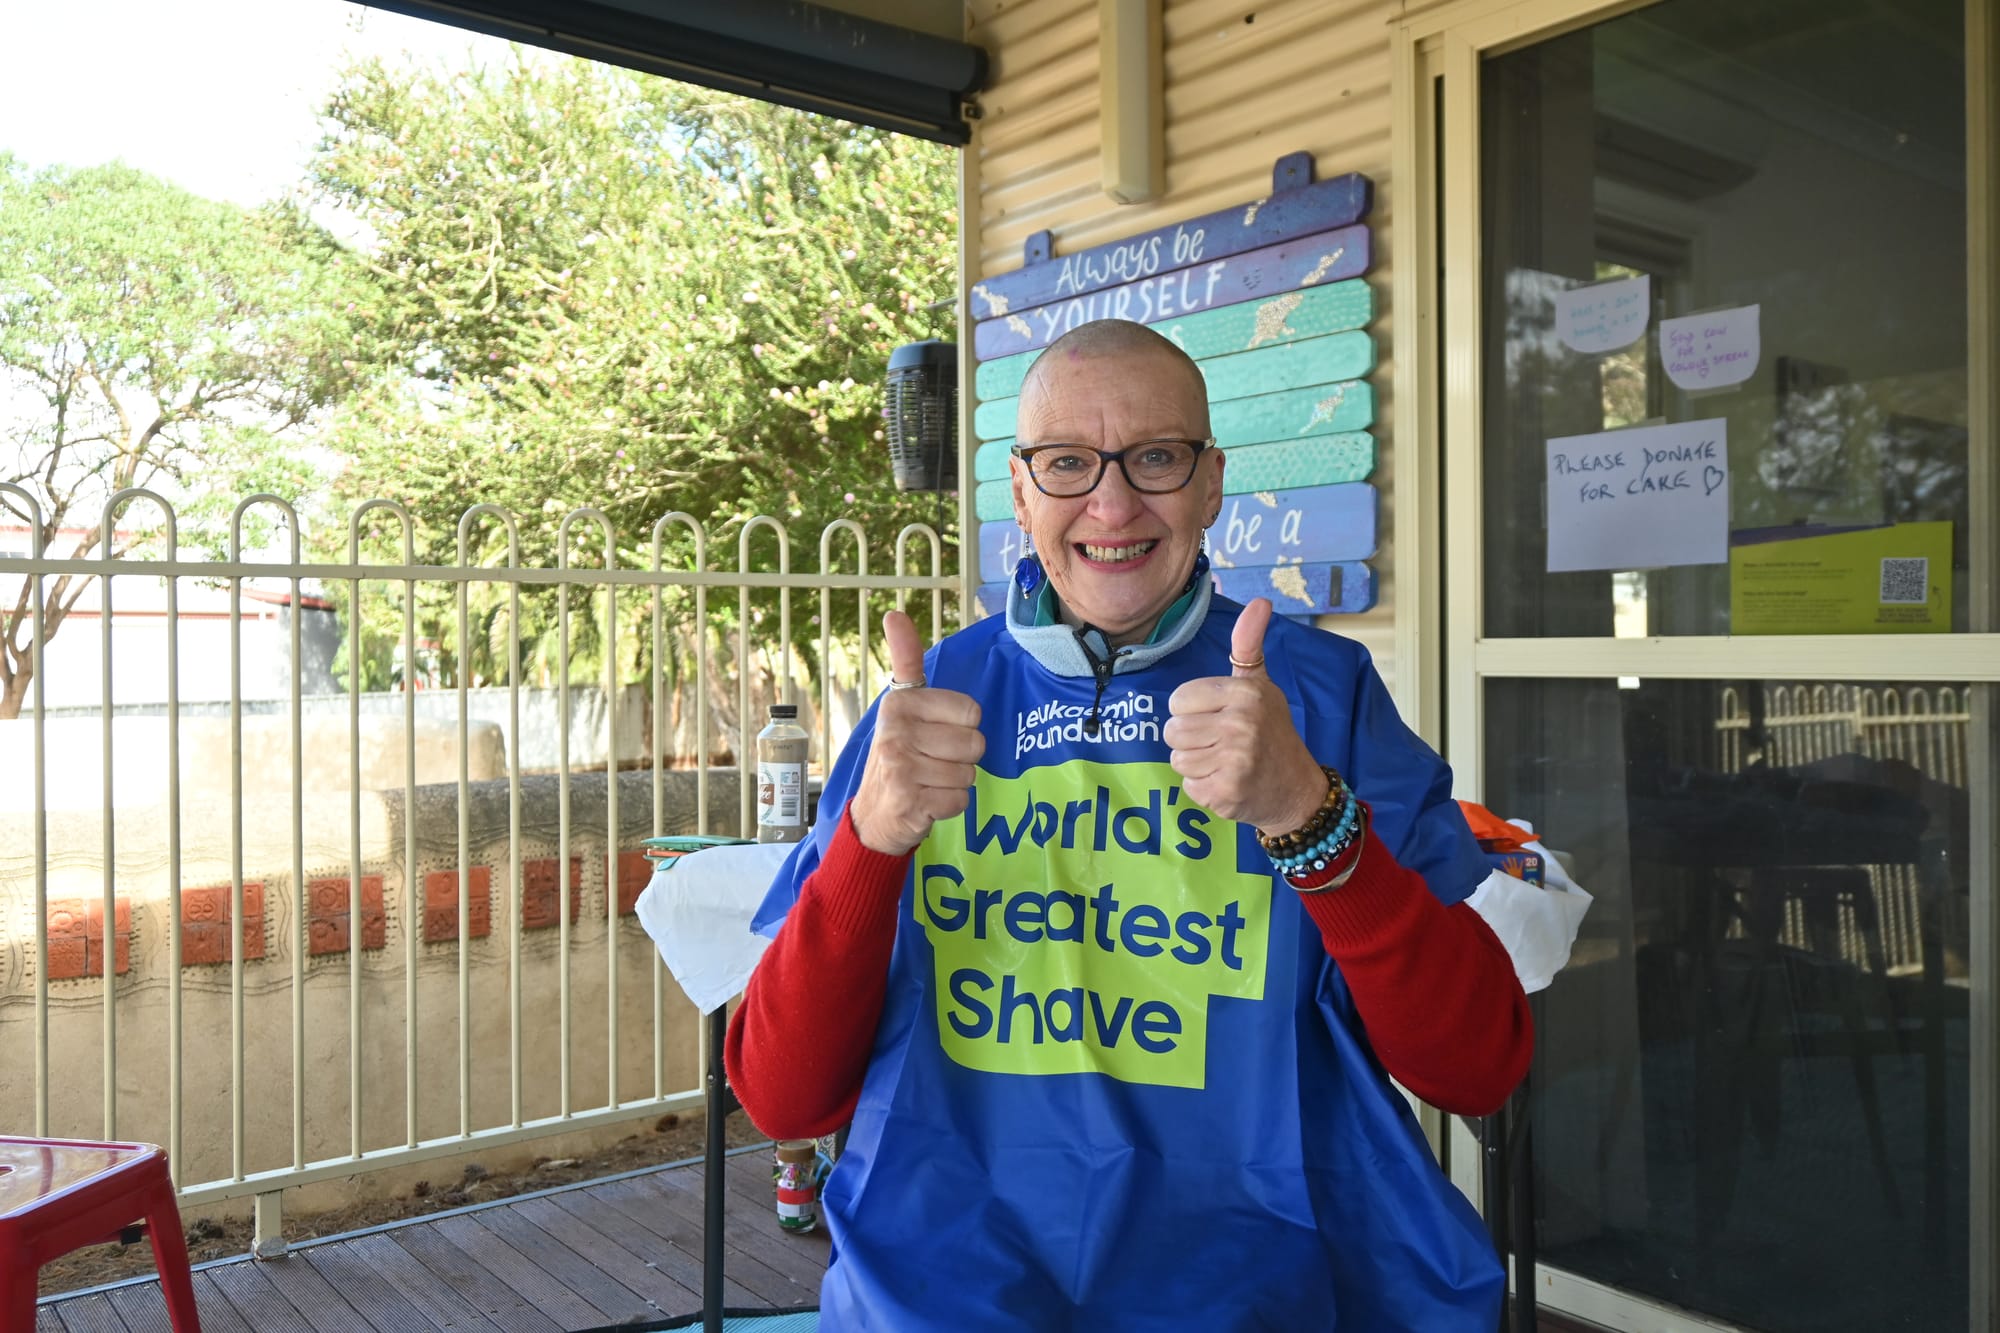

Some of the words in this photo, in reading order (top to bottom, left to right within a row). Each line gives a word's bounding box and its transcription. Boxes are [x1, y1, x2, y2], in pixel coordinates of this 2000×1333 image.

[1056, 236, 1162, 294] Always
[1174, 224, 1205, 263] be
[1043, 261, 1226, 343] YOURSELF
[1554, 452, 1626, 475] PLEASE
[1641, 440, 1717, 480] DONATE
[1580, 482, 1615, 502] FOR
[1626, 470, 1691, 494] CAKE
[1225, 500, 1262, 554] be
[1280, 509, 1303, 545] a
[1015, 717, 1159, 760] Foundation
[1017, 691, 1153, 736] Leukaemia
[964, 785, 1213, 860] World's
[922, 864, 1246, 971] Greatest
[947, 968, 1182, 1054] Shave
